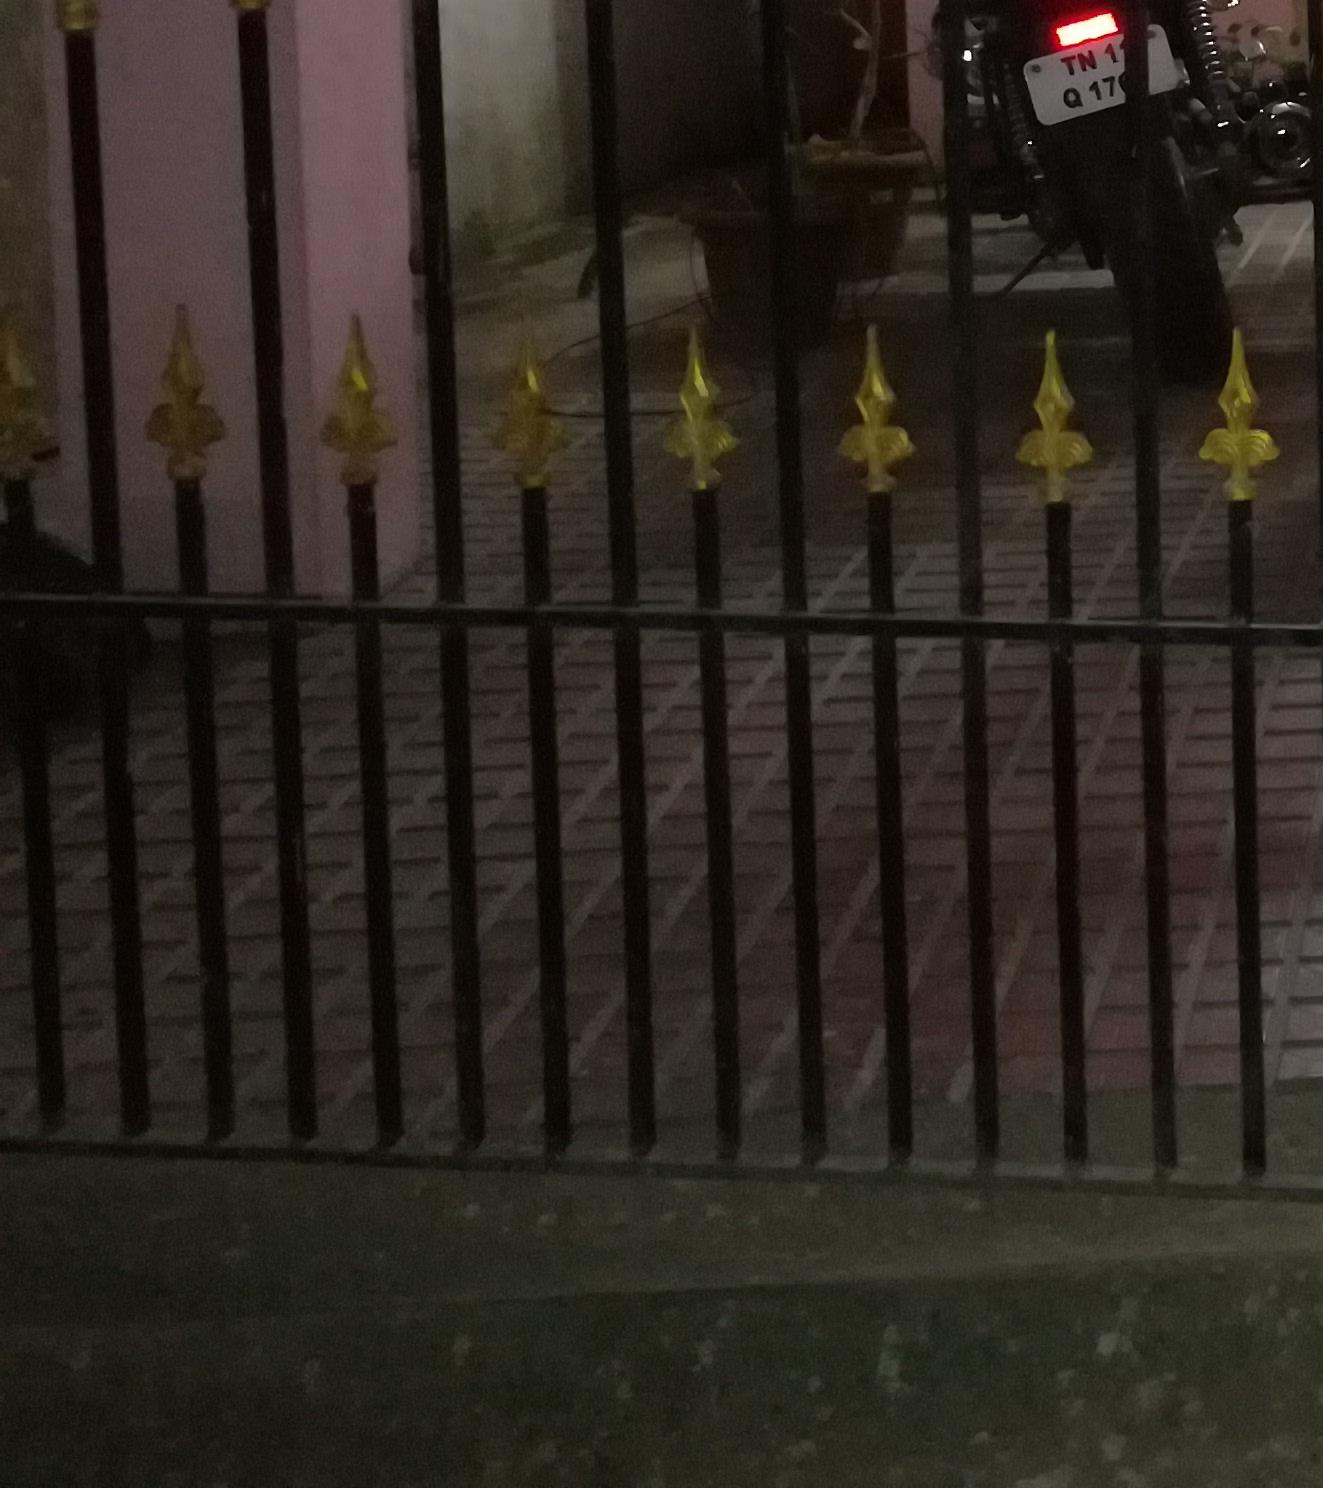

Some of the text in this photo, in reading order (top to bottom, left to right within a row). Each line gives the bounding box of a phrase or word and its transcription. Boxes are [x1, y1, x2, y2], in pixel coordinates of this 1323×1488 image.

[1060, 42, 1126, 76] TN 1
[1063, 75, 1126, 108] Q 17
